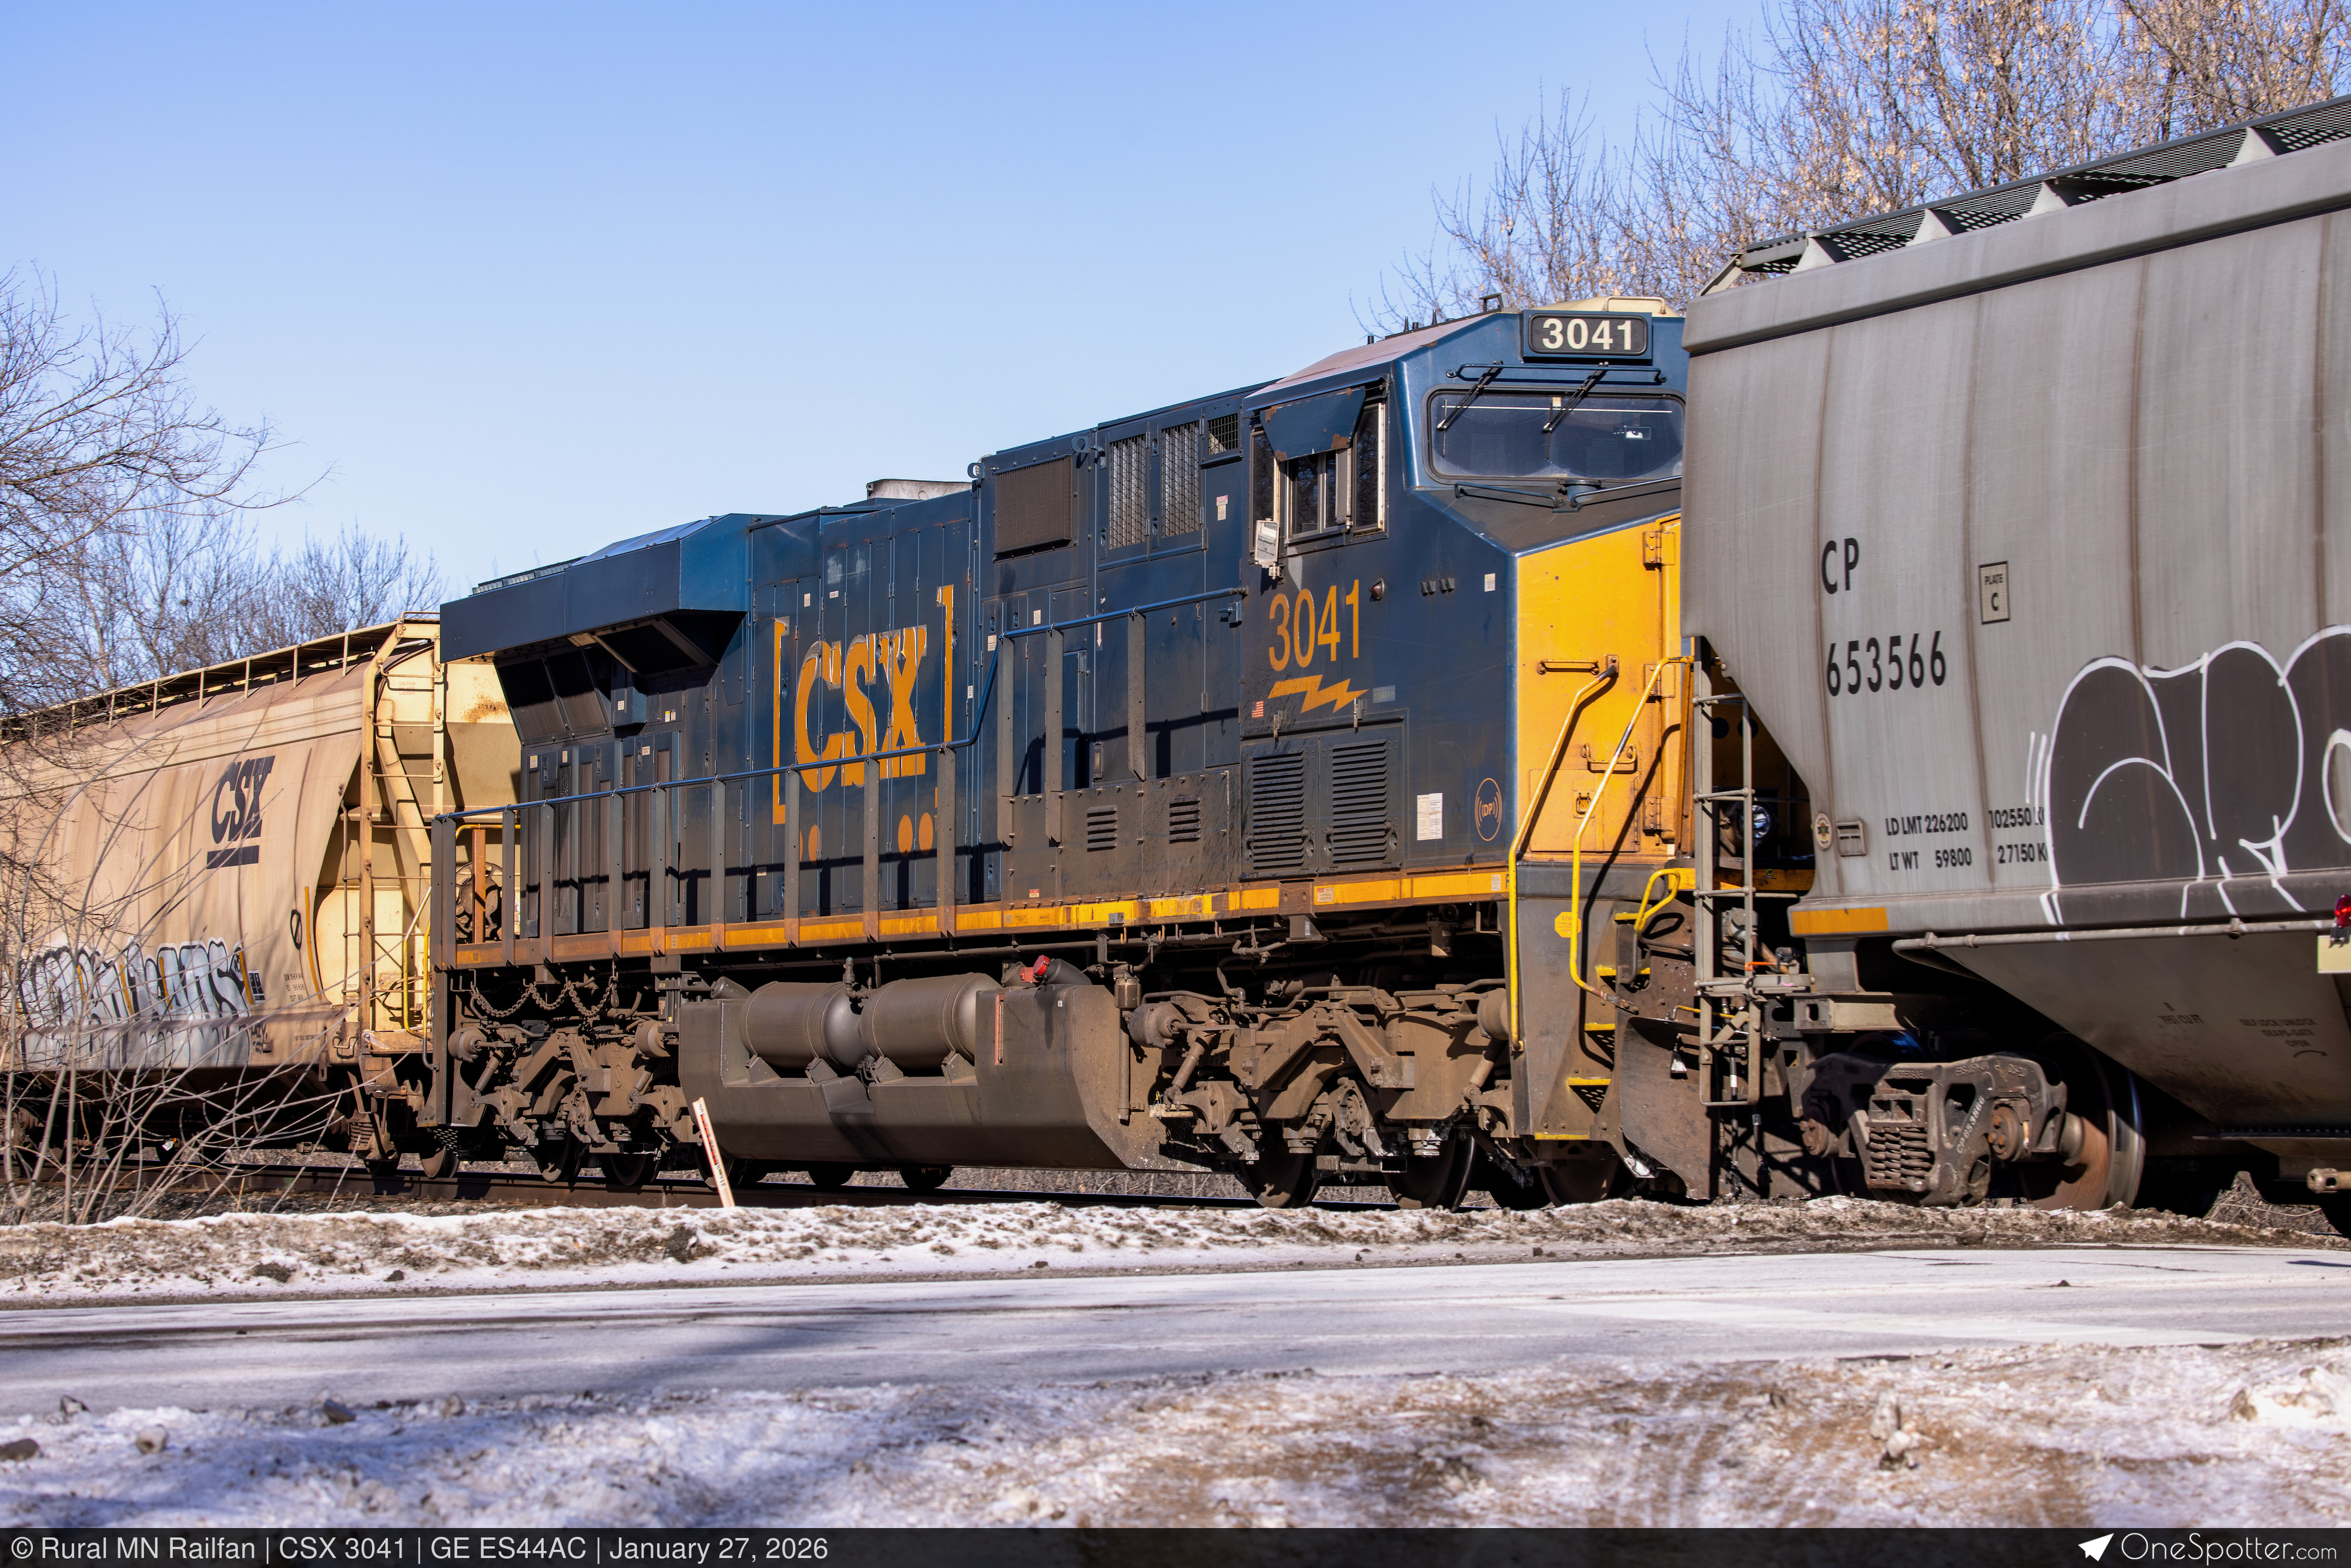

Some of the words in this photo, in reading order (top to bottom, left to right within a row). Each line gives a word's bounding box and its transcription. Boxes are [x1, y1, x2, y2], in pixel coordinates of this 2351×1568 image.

[1542, 318, 1631, 350] 3041
[1821, 538, 1860, 595] CP
[1984, 574, 2003, 586] PLATE
[1991, 592, 2000, 611] C
[1268, 579, 1359, 671] 3041
[1827, 630, 1947, 697] 653566
[794, 624, 927, 793] CSX
[210, 755, 276, 845] CSX
[1483, 803, 1493, 816] DP
[1886, 817, 1900, 836] LD
[1901, 816, 1923, 835] LMT
[1925, 812, 1968, 833] 226200
[1988, 808, 2032, 829] 102550
[1889, 852, 1900, 871] LT
[1901, 851, 1919, 870] WT
[1935, 847, 1972, 868] 59800
[1998, 843, 2035, 864] 27150
[2037, 842, 2049, 862] K
